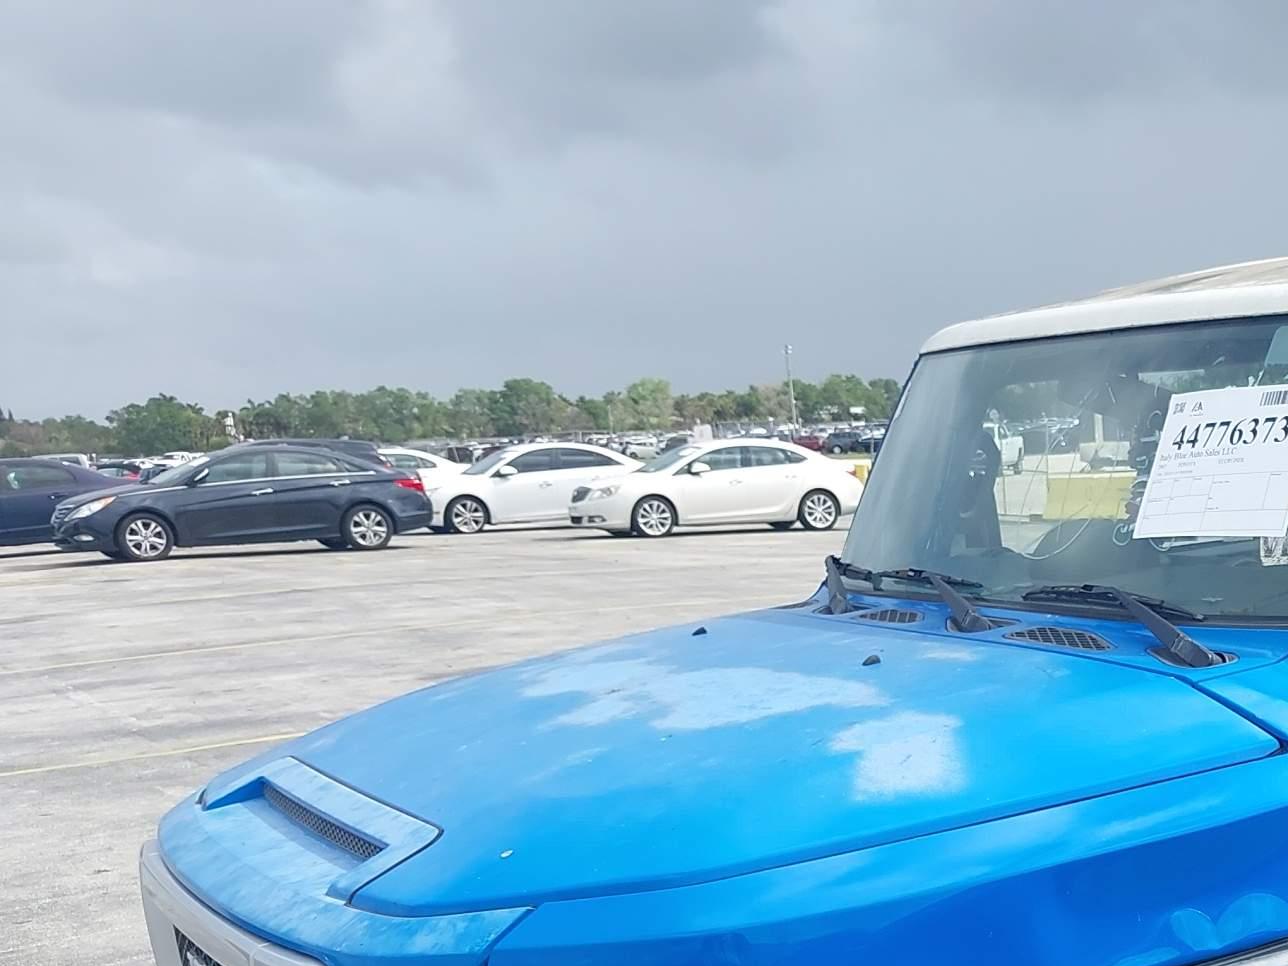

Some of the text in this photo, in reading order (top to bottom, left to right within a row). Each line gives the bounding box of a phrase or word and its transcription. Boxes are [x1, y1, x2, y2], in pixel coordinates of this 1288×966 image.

[1174, 452, 1187, 460] Blue
[1189, 450, 1203, 458] Auto
[1205, 448, 1220, 457] Sales
[1221, 447, 1237, 455] LLC
